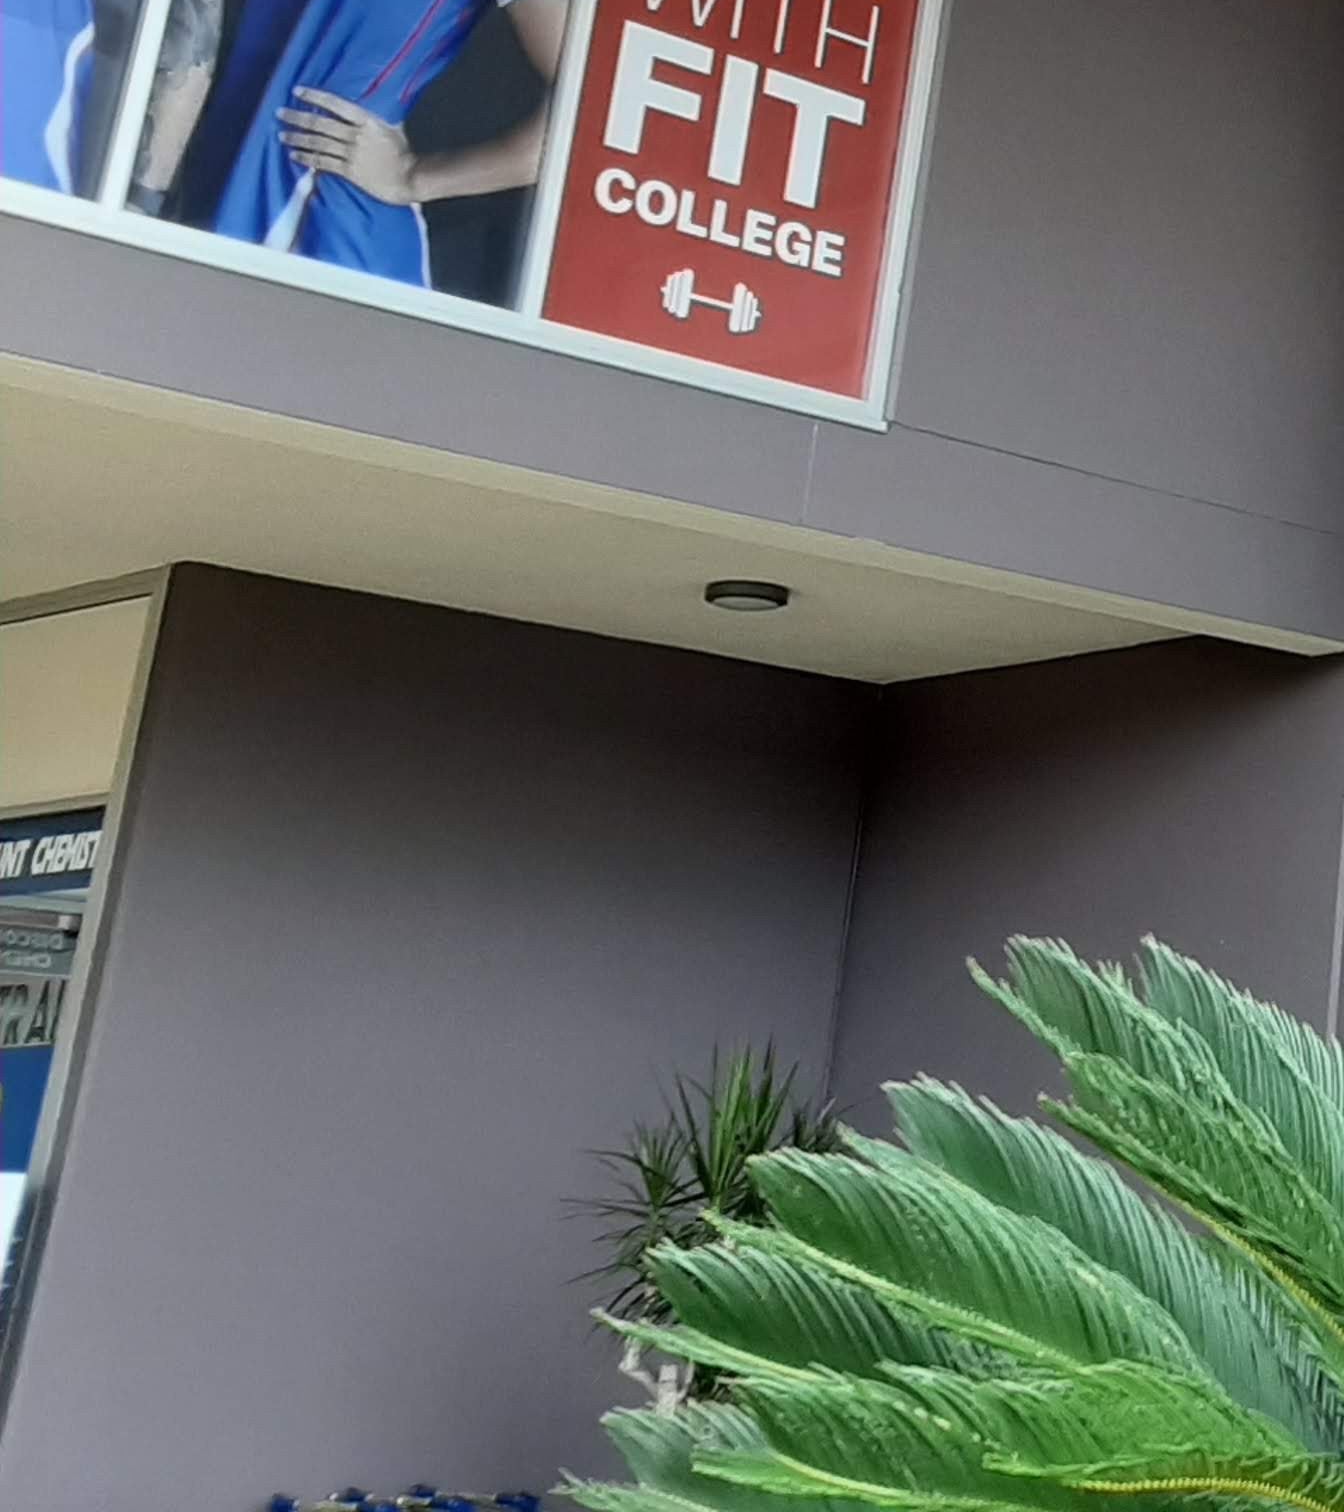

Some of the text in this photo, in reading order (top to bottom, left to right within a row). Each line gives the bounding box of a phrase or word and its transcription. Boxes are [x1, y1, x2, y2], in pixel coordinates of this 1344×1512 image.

[602, 19, 866, 209] FIT
[594, 167, 846, 277] COLLEGE
[31, 830, 102, 875] CHEMIST
